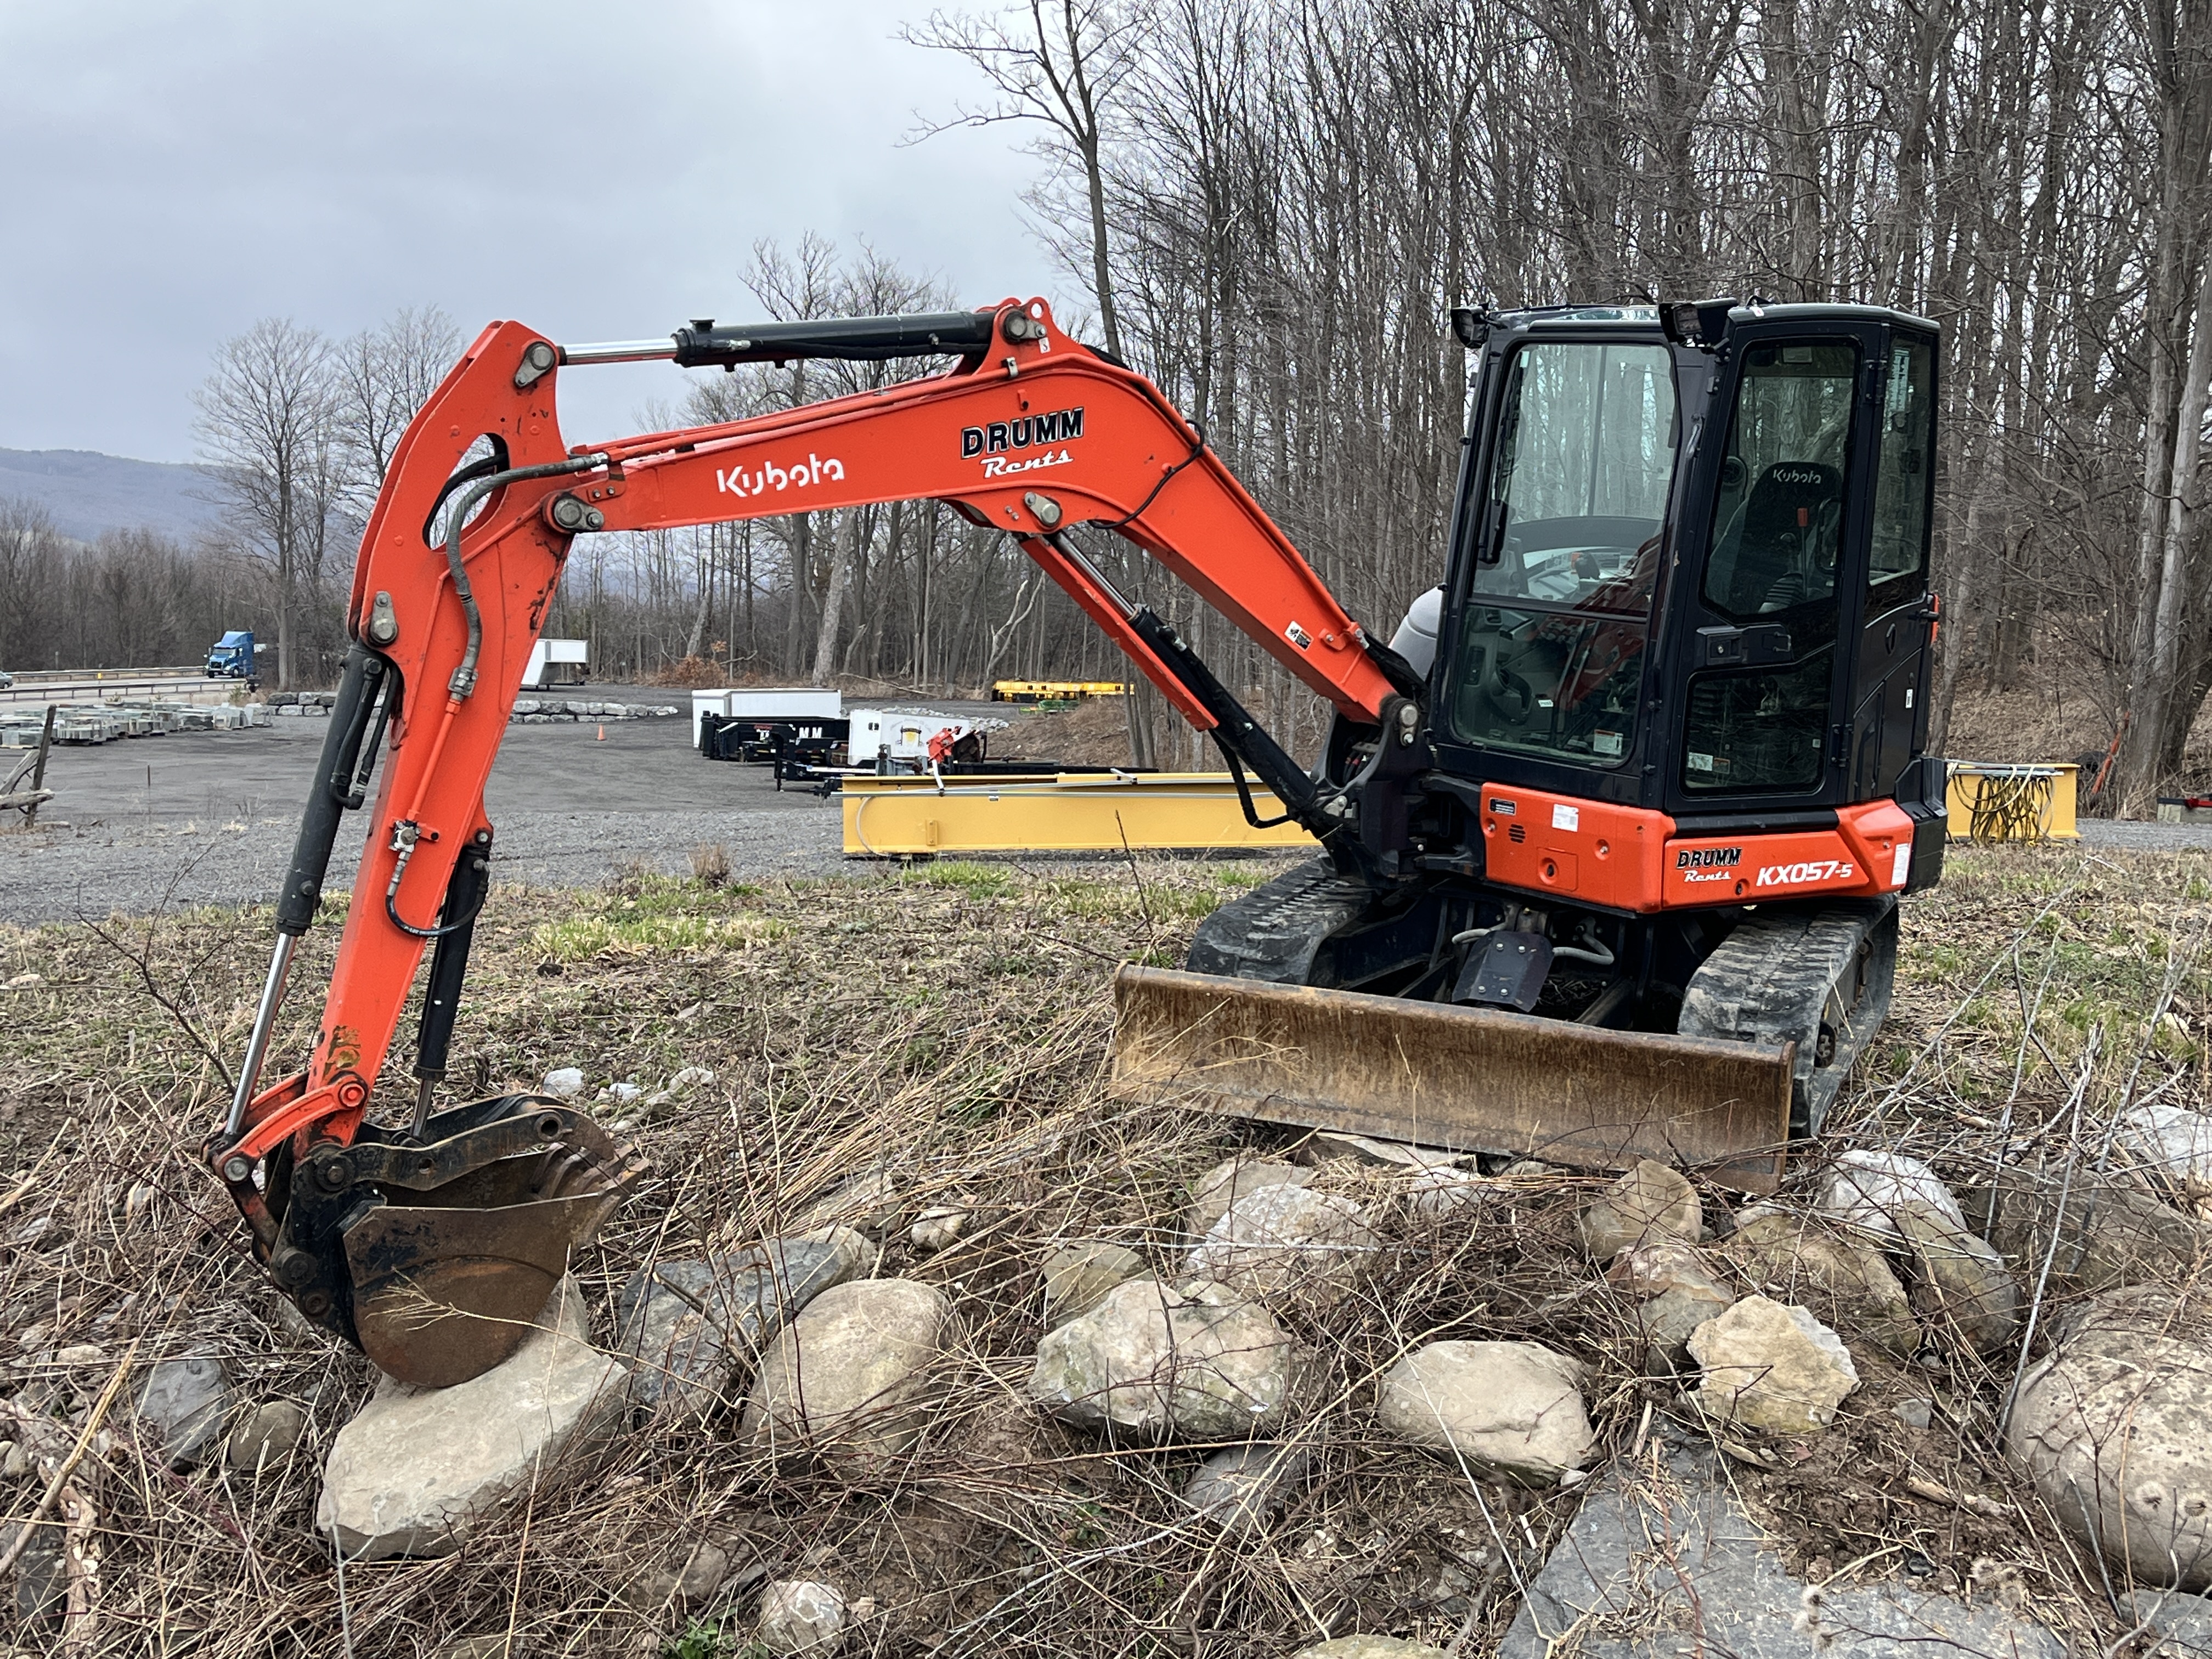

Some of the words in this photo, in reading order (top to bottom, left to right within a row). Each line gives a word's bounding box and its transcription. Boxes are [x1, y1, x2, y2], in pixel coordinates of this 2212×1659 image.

[961, 407, 1085, 460] DRUMM
[716, 453, 845, 498] Kubota
[980, 449, 1074, 478] Rents
[1773, 469, 1821, 484] Kubota
[1676, 847, 1742, 869] DRUMM
[1684, 870, 1731, 883] Rents
[1756, 860, 1853, 887] KX057-5
